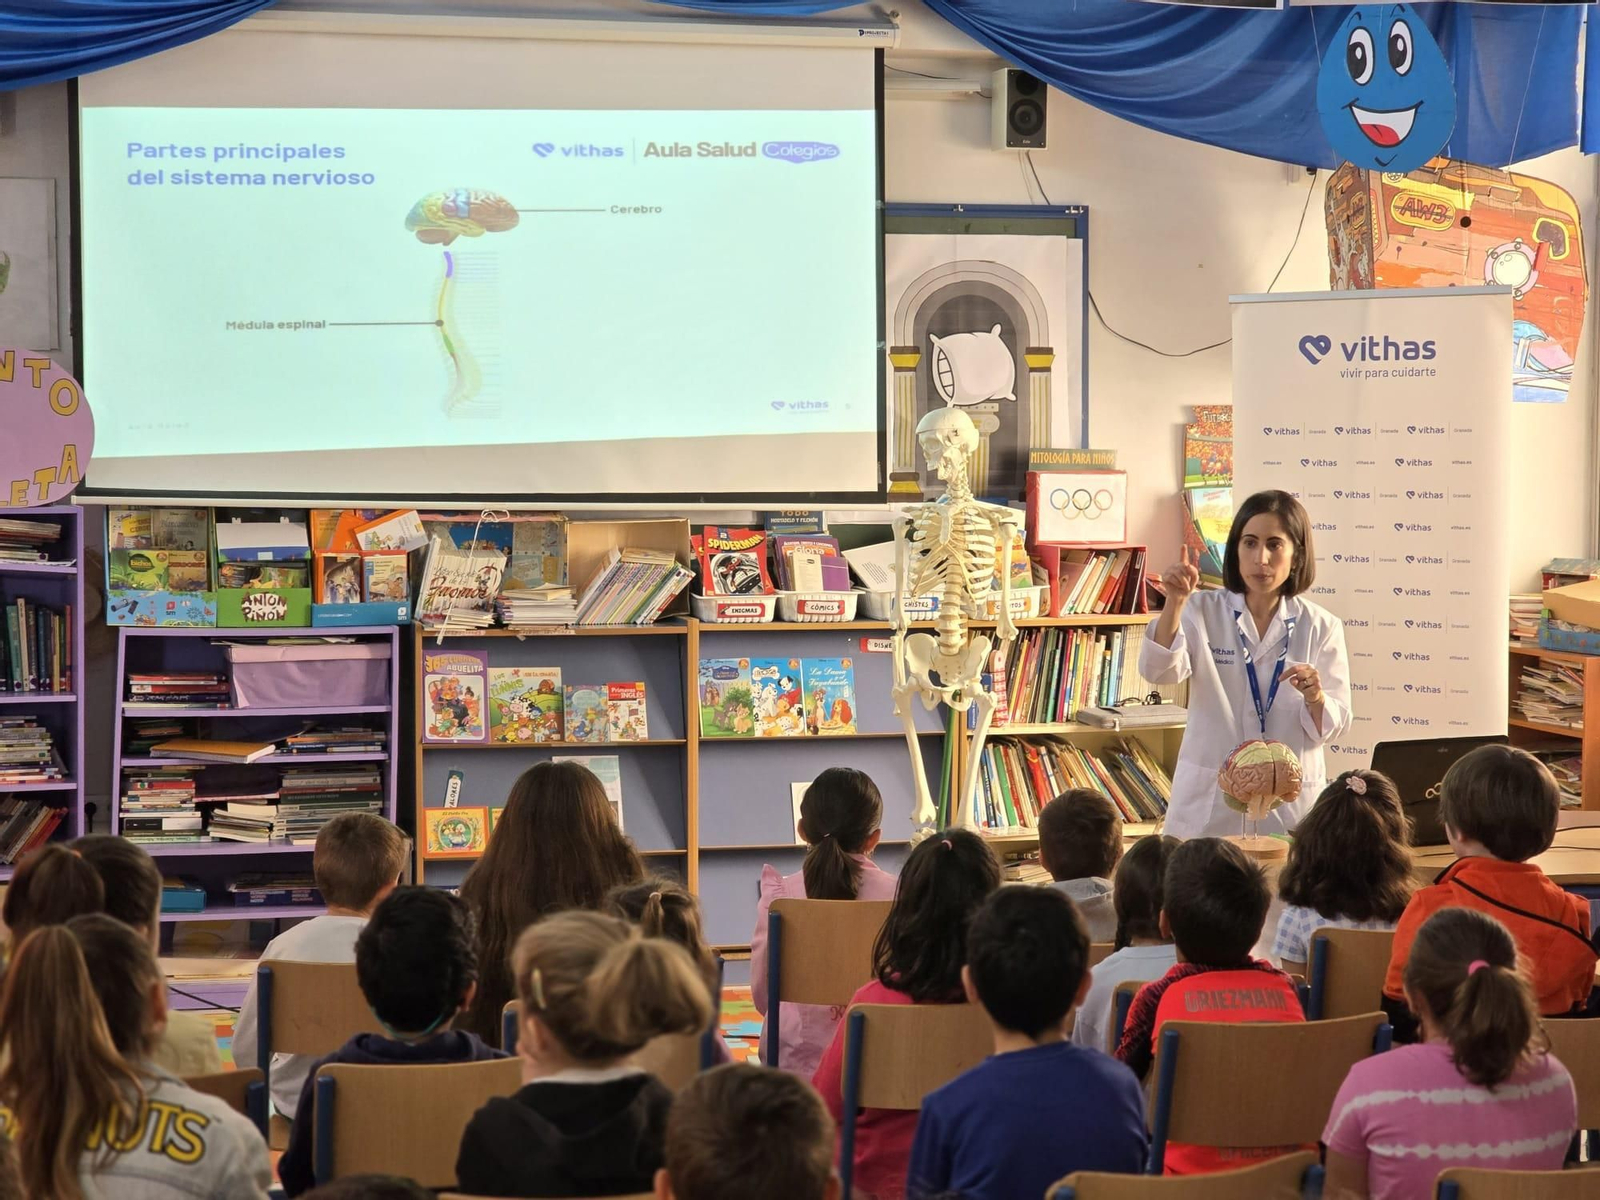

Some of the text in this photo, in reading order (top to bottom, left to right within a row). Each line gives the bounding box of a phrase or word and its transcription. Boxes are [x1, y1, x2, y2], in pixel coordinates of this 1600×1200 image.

[127, 142, 345, 162] Partes principales
[561, 141, 838, 161] vithas Aula Salud Colegios
[128, 169, 375, 186] del sistema nervioso
[610, 205, 662, 214] Cerebro
[225, 320, 326, 331] Médula espinal
[1341, 335, 1436, 362] vithas
[1340, 367, 1436, 380] vivir para cuidarte
[788, 400, 829, 410] vithas
[1274, 427, 1300, 436] vithas
[1345, 426, 1371, 435] vithas
[1418, 426, 1445, 434] vithas
[1030, 451, 1115, 465] MITOLOGÍA PARA NIÑOS
[1311, 458, 1337, 467] vithas
[1406, 458, 1432, 467] vithas
[1344, 490, 1370, 499] vithas
[1417, 491, 1443, 499] vithas
[1311, 523, 1337, 531] vithas
[1405, 523, 1432, 531] vithas
[707, 534, 765, 551] SPIDERMAN
[1344, 554, 1370, 563] vithas
[1416, 555, 1443, 564] vithas
[1310, 586, 1336, 595] vithas
[1404, 588, 1431, 596] vithas
[810, 603, 834, 611] CÓMICS
[996, 601, 1022, 609] CTOS
[1343, 618, 1369, 627] vithas
[1415, 620, 1442, 629] vithas
[874, 642, 893, 650] DISNE
[1404, 652, 1430, 661] vithas
[447, 664, 484, 673] ABUELITA
[1350, 682, 1368, 691] thas
[1414, 685, 1441, 694] vithas
[1403, 717, 1429, 726] vithas
[1341, 745, 1368, 754] vithas
[1185, 988, 1287, 1012] GRIEZMANN
